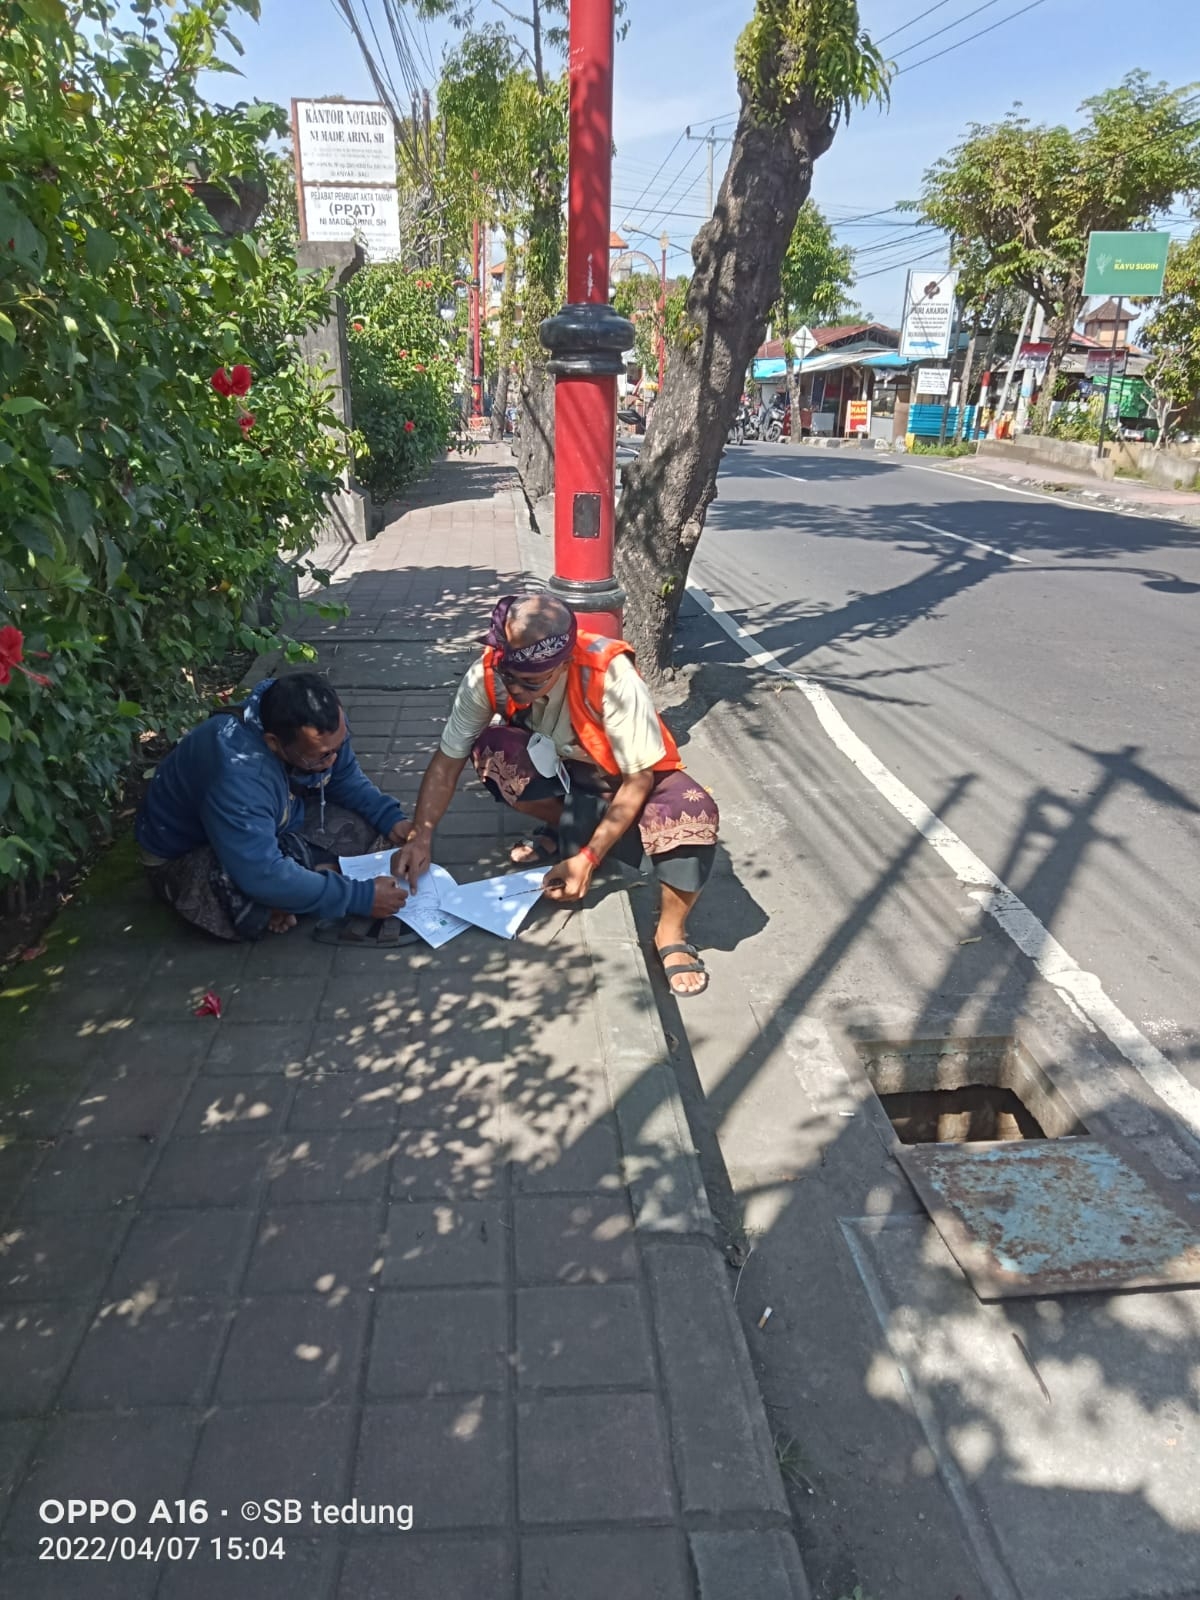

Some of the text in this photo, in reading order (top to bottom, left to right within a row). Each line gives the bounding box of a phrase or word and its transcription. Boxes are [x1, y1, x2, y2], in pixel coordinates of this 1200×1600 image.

[305, 108, 387, 126] KANTOR NOTARIS
[310, 130, 319, 142] NI
[321, 131, 345, 143] MADE
[374, 133, 385, 144] SH
[311, 192, 392, 202] PEJABAT PEMBUAT AKTA TANAH
[329, 202, 375, 216] (PPAT)
